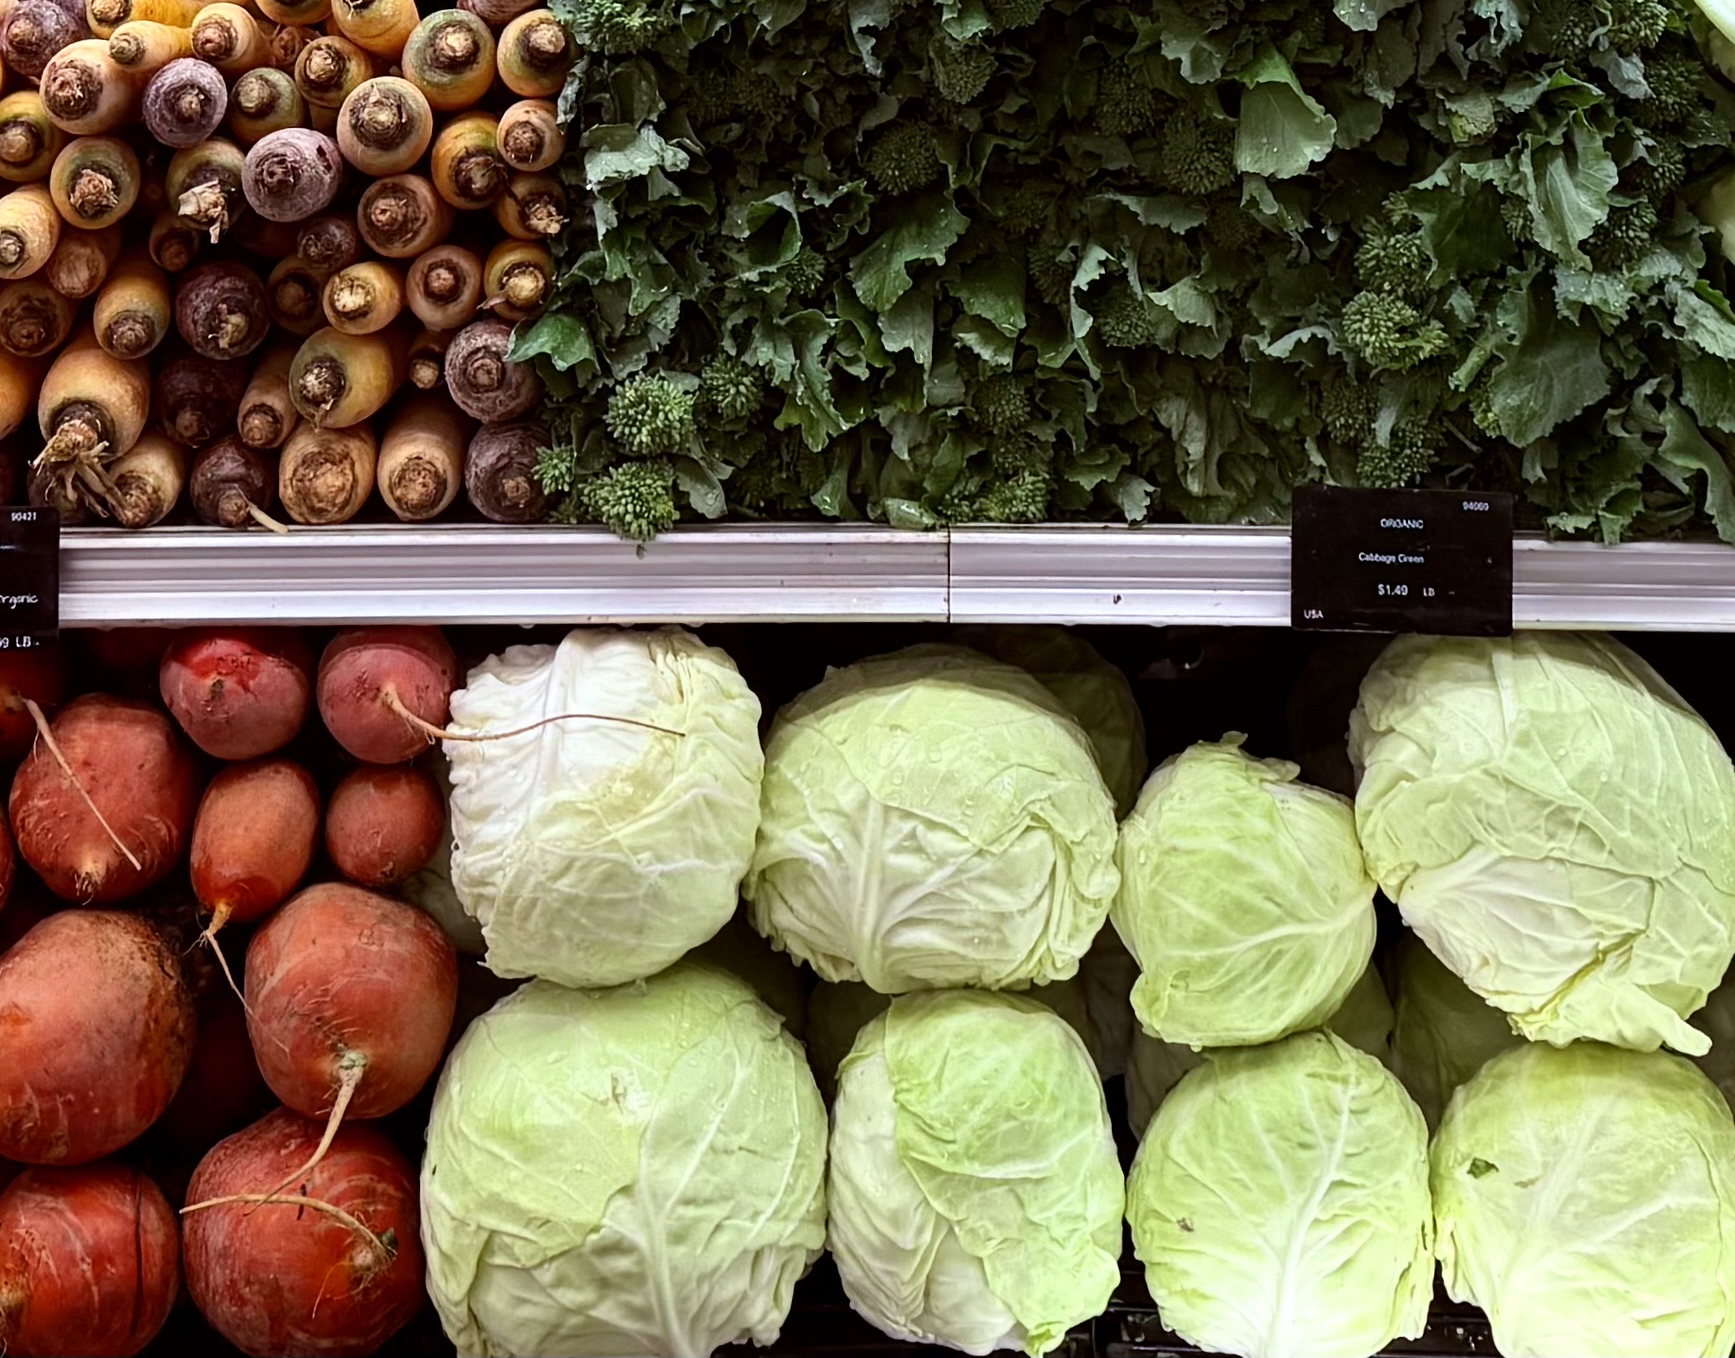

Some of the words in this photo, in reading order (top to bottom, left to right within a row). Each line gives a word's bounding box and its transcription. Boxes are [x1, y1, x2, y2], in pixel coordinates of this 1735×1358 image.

[1381, 518, 1423, 528] ORGANIC
[1359, 552, 1395, 564] Cabbage
[1398, 553, 1424, 564] Green
[1378, 584, 1408, 595] $1.49
[1423, 587, 1434, 596] LB
[1304, 610, 1323, 619] USA
[16, 636, 31, 647] LB
